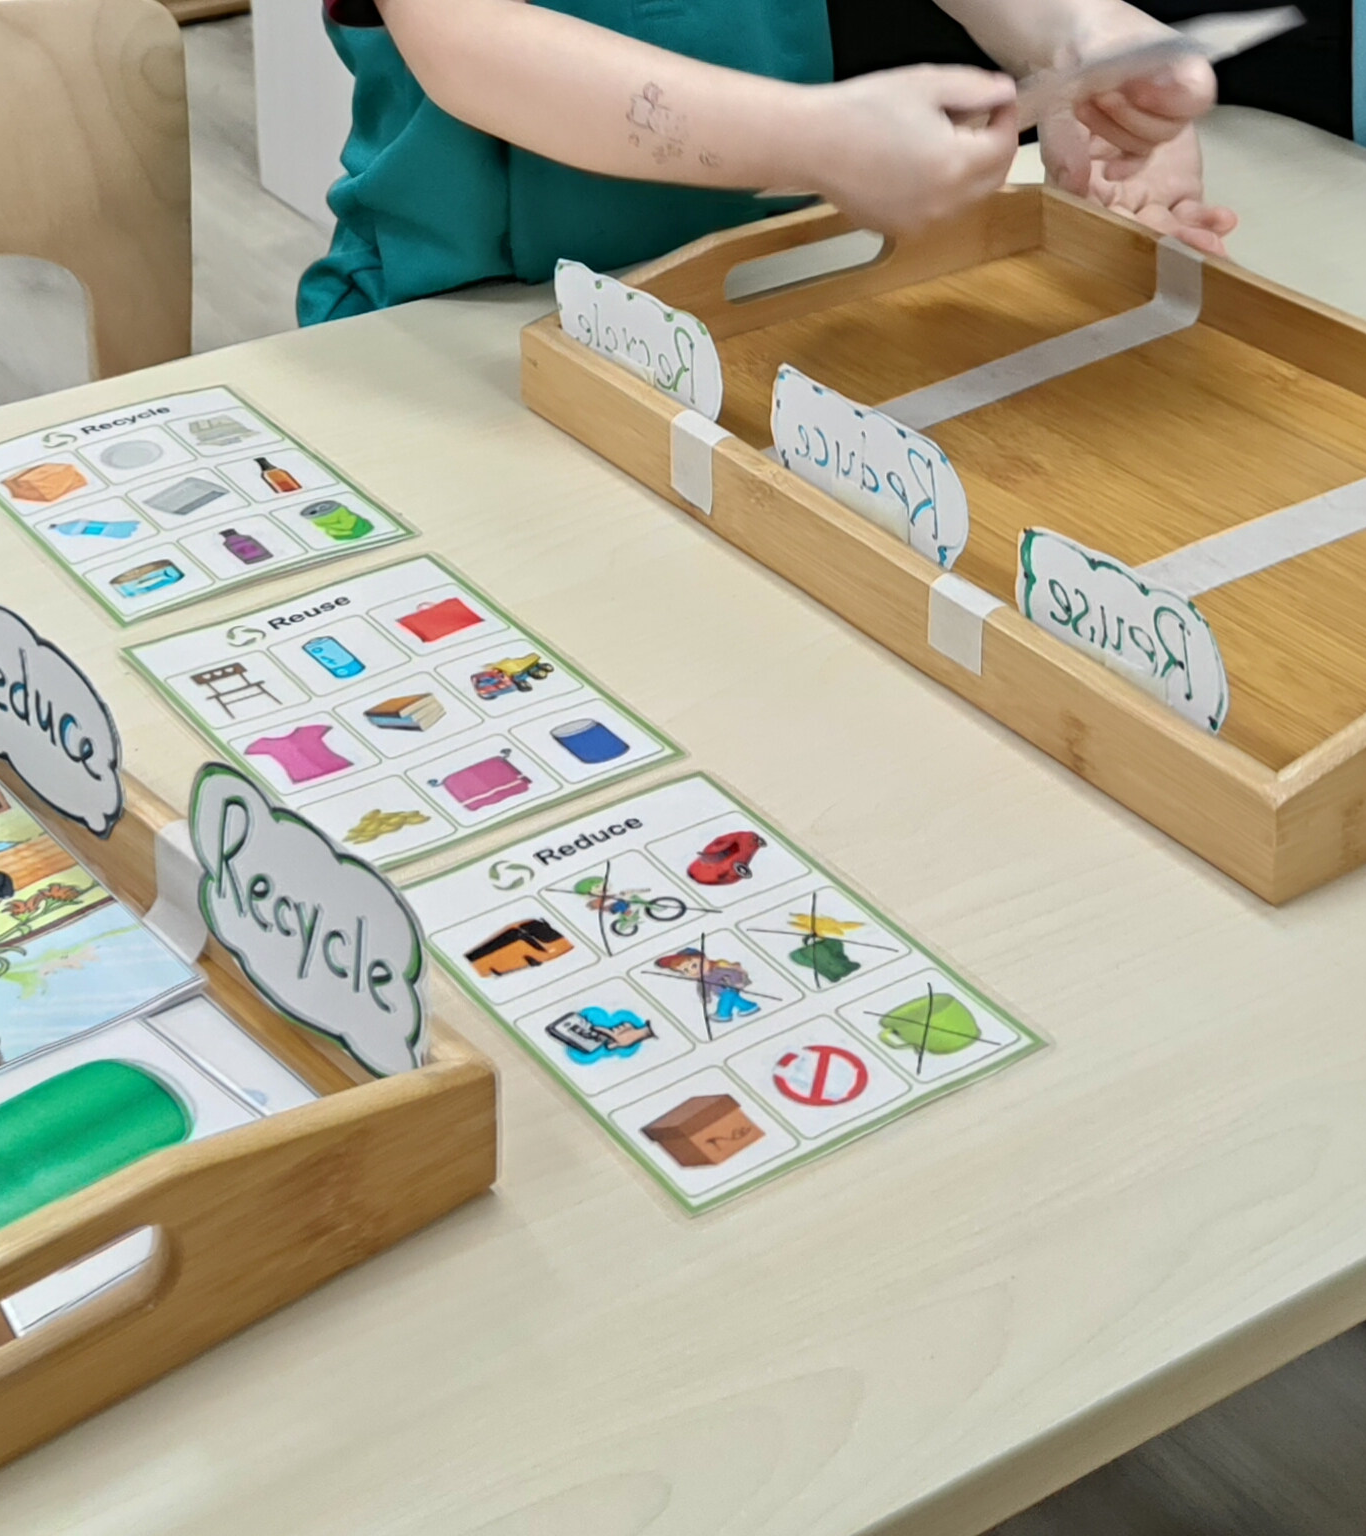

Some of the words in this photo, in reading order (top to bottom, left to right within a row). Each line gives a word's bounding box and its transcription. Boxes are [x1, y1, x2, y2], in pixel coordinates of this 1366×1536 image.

[79, 399, 171, 439] Recycle
[265, 590, 352, 634] Reuse
[532, 812, 645, 870] Reduce
[219, 792, 397, 1014] Recycle
